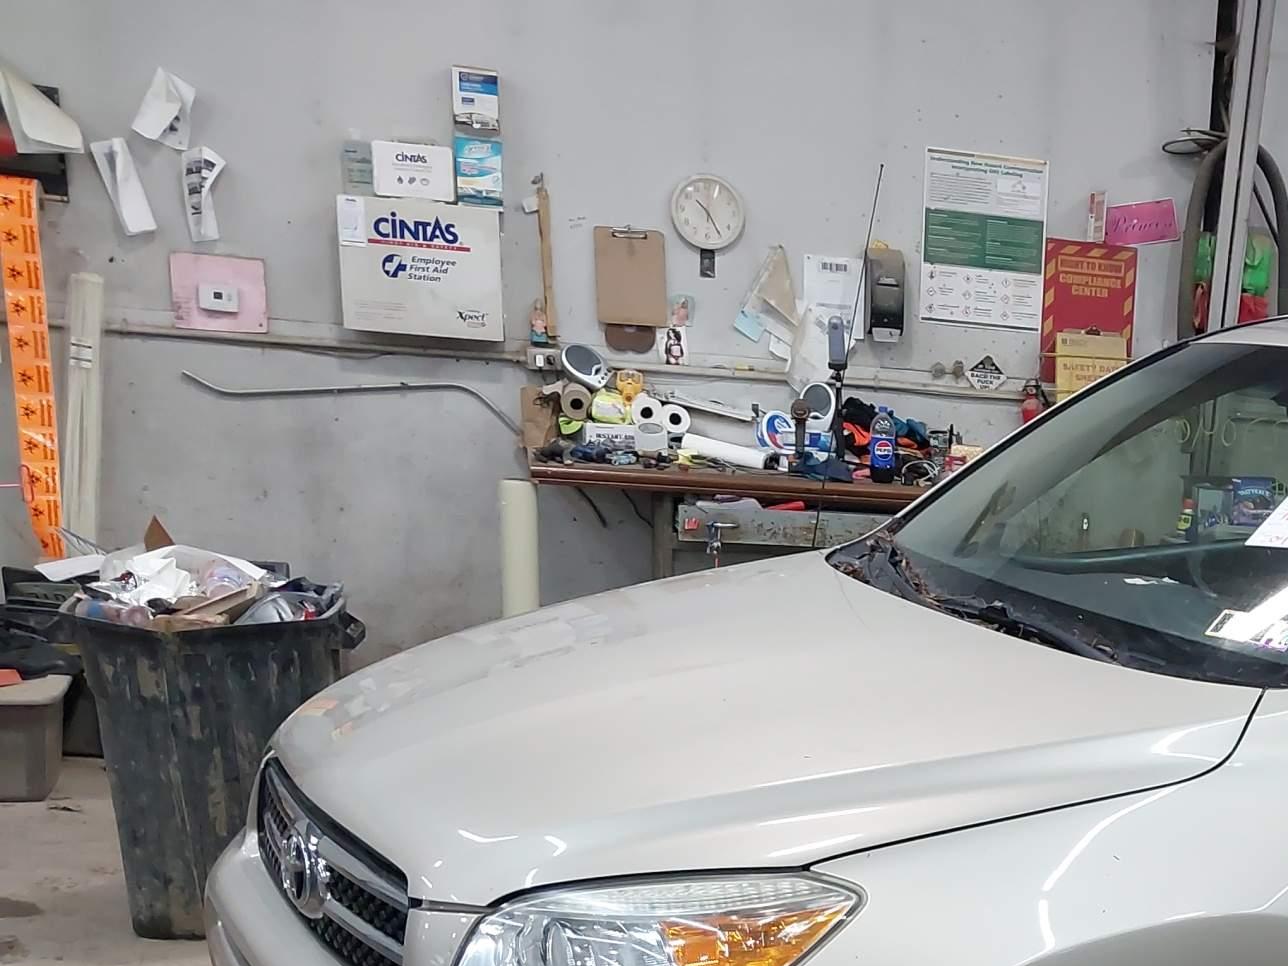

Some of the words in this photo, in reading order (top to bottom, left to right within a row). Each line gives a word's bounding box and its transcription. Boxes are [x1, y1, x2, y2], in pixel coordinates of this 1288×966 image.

[411, 255, 457, 267] Employee
[409, 264, 430, 273] First
[432, 266, 448, 274] Aid
[407, 273, 442, 283] Station
[1059, 273, 1122, 288] COMPLIANCE
[1071, 285, 1109, 298] CENTER
[456, 311, 486, 323] Xpect
[1062, 362, 1097, 373] SAFETY
